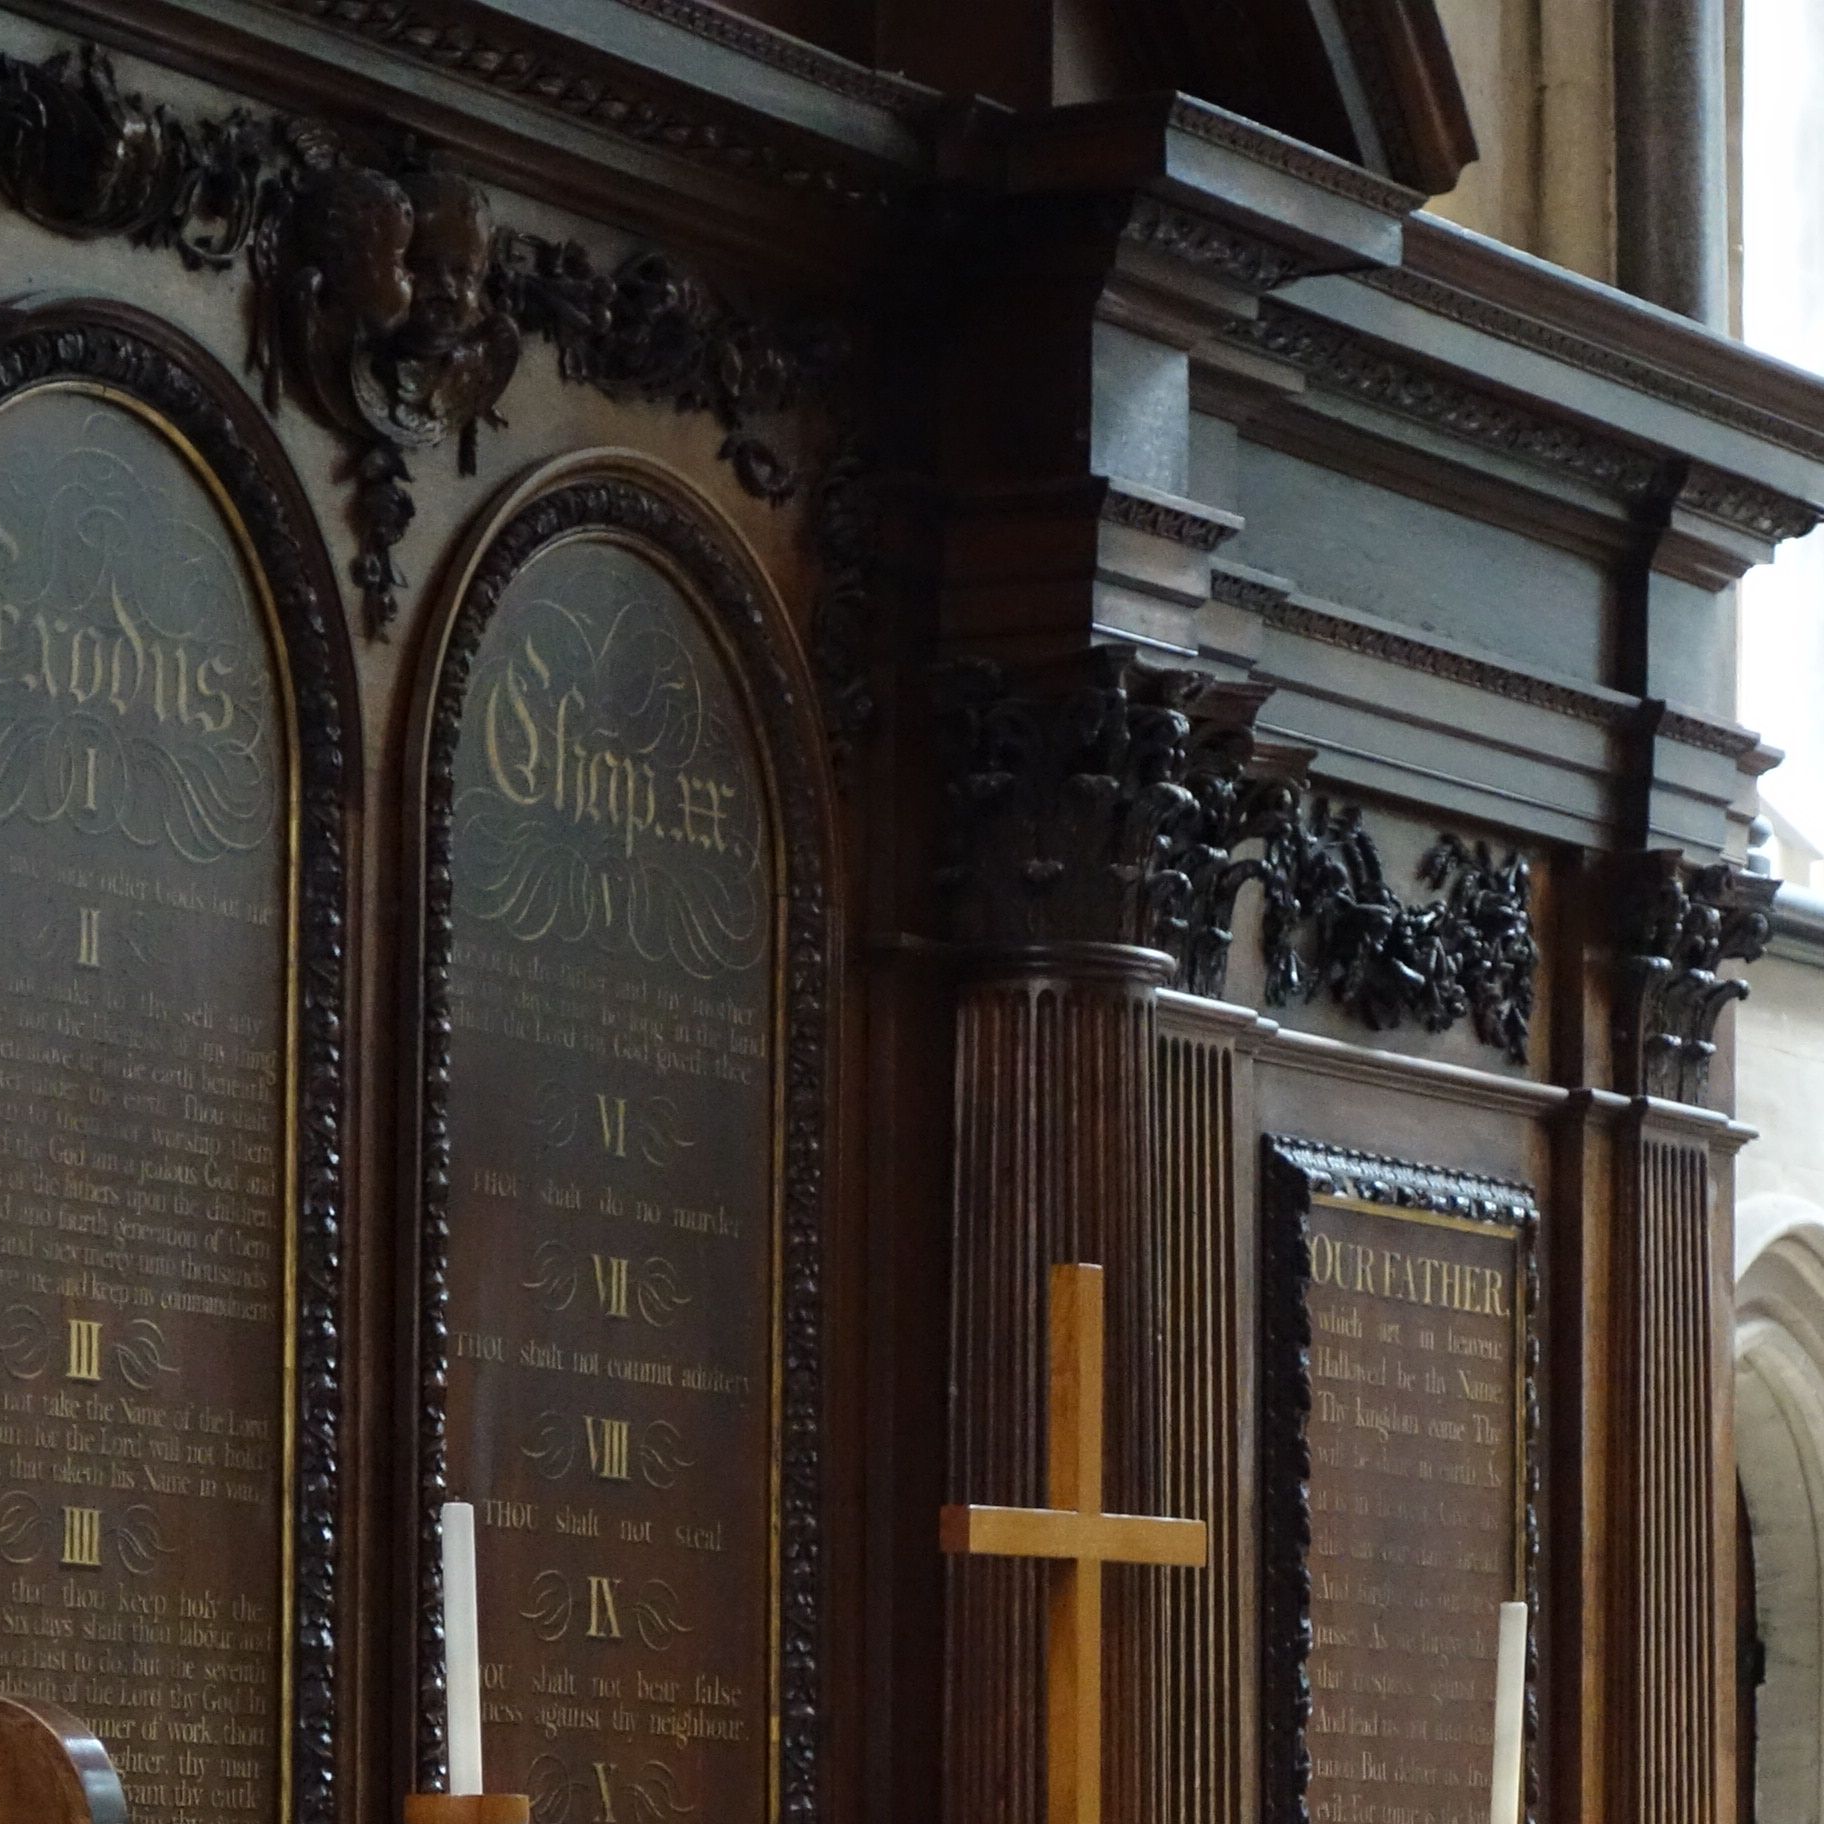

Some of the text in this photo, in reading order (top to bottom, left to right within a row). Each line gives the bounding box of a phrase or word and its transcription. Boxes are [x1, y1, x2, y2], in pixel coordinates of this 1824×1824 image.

[84, 747, 99, 811] I
[78, 907, 102, 968] II
[595, 1092, 626, 1158] VI
[599, 1186, 625, 1217] do
[636, 1199, 662, 1224] no
[590, 1252, 630, 1318] VII
[1311, 1233, 1375, 1295] OUR
[1317, 1304, 1363, 1339] which
[65, 1318, 104, 1381] III
[454, 1331, 674, 1387] THOU shalt not commit
[1317, 1346, 1446, 1403] Hallowed be thy
[43, 1389, 80, 1419] take
[85, 1392, 114, 1423] the
[120, 1397, 167, 1428] Name
[172, 1401, 195, 1431] of
[198, 1405, 224, 1434] the
[1317, 1389, 1347, 1432] Thy
[1355, 1396, 1420, 1443] kingdom
[66, 1423, 95, 1453] the
[99, 1426, 142, 1458] Lord
[149, 1436, 180, 1462] will
[186, 1444, 215, 1466] not
[582, 1414, 631, 1481] VIII
[9, 1451, 218, 1498] that his Name in
[60, 1506, 104, 1566] IIII
[485, 1500, 723, 1552] THOU shalt not steal
[117, 1581, 167, 1624] keep
[179, 1588, 222, 1620] holy
[231, 1593, 263, 1622] the
[585, 1575, 624, 1638] IX
[83, 1613, 233, 1650] shalt labour
[74, 1651, 92, 1673] to
[132, 1650, 160, 1677] but
[531, 1665, 743, 1707] shalt not bear false
[120, 1679, 240, 1713] Lord God
[141, 1714, 163, 1741] of
[535, 1702, 603, 1740] against
[612, 1702, 640, 1744] thy
[178, 1749, 209, 1783] thy
[1362, 1750, 1387, 1781] But
[592, 1761, 620, 1824] X
